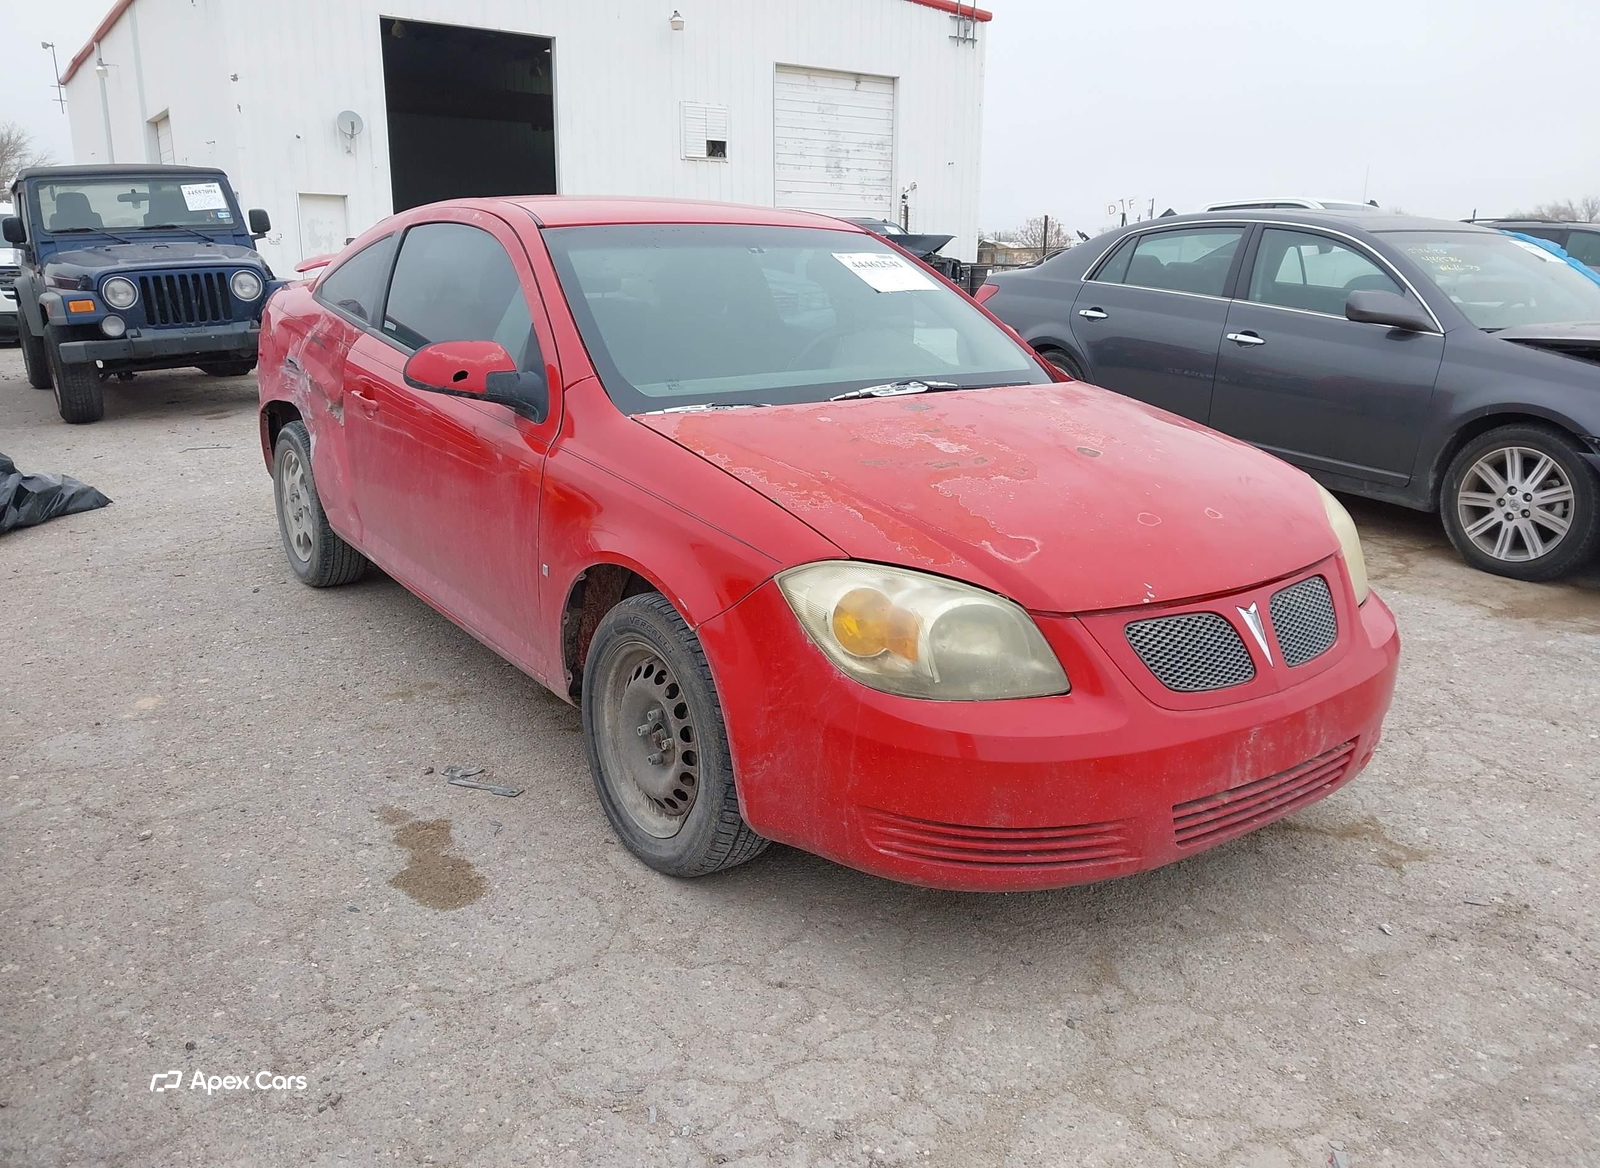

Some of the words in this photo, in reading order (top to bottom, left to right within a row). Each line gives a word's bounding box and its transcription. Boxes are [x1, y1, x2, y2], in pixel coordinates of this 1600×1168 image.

[1128, 199, 1134, 209] F
[1108, 204, 1116, 215] D
[851, 260, 904, 270] 44462541
[629, 616, 674, 653] VERCELLI
